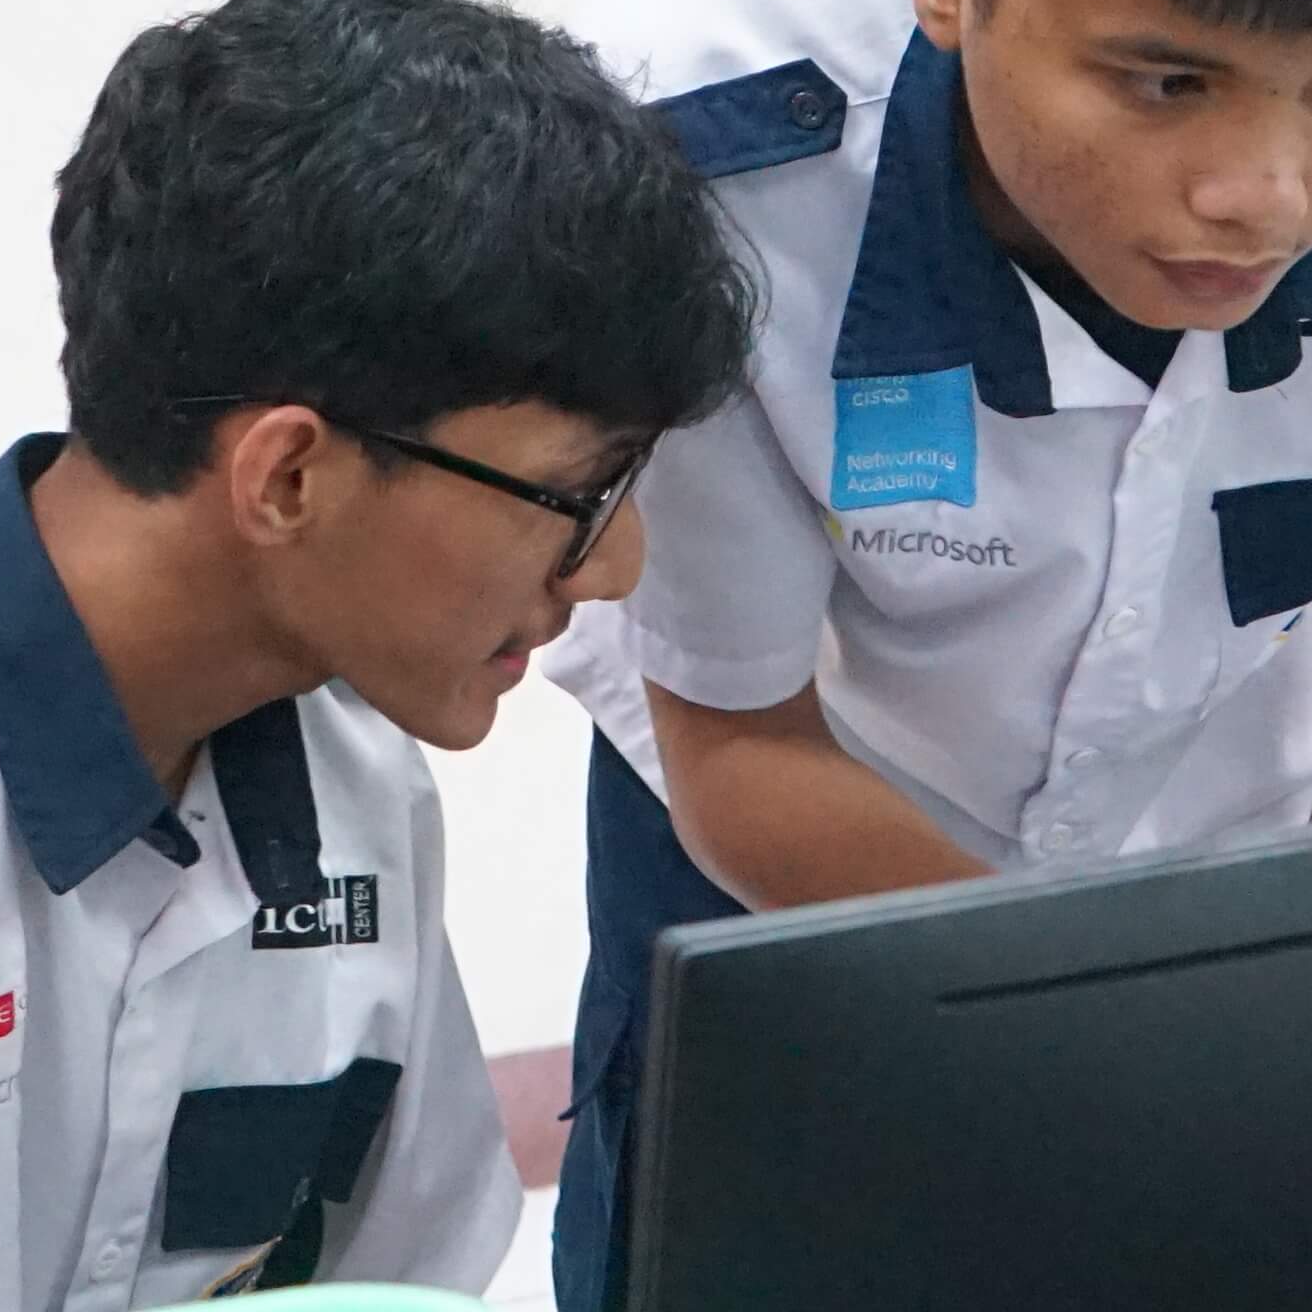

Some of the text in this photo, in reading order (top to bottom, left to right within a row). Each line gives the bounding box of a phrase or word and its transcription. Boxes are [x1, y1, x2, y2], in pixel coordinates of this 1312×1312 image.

[847, 449, 957, 471] Networking
[847, 470, 939, 493] Academy
[852, 528, 1017, 567] Microsoft
